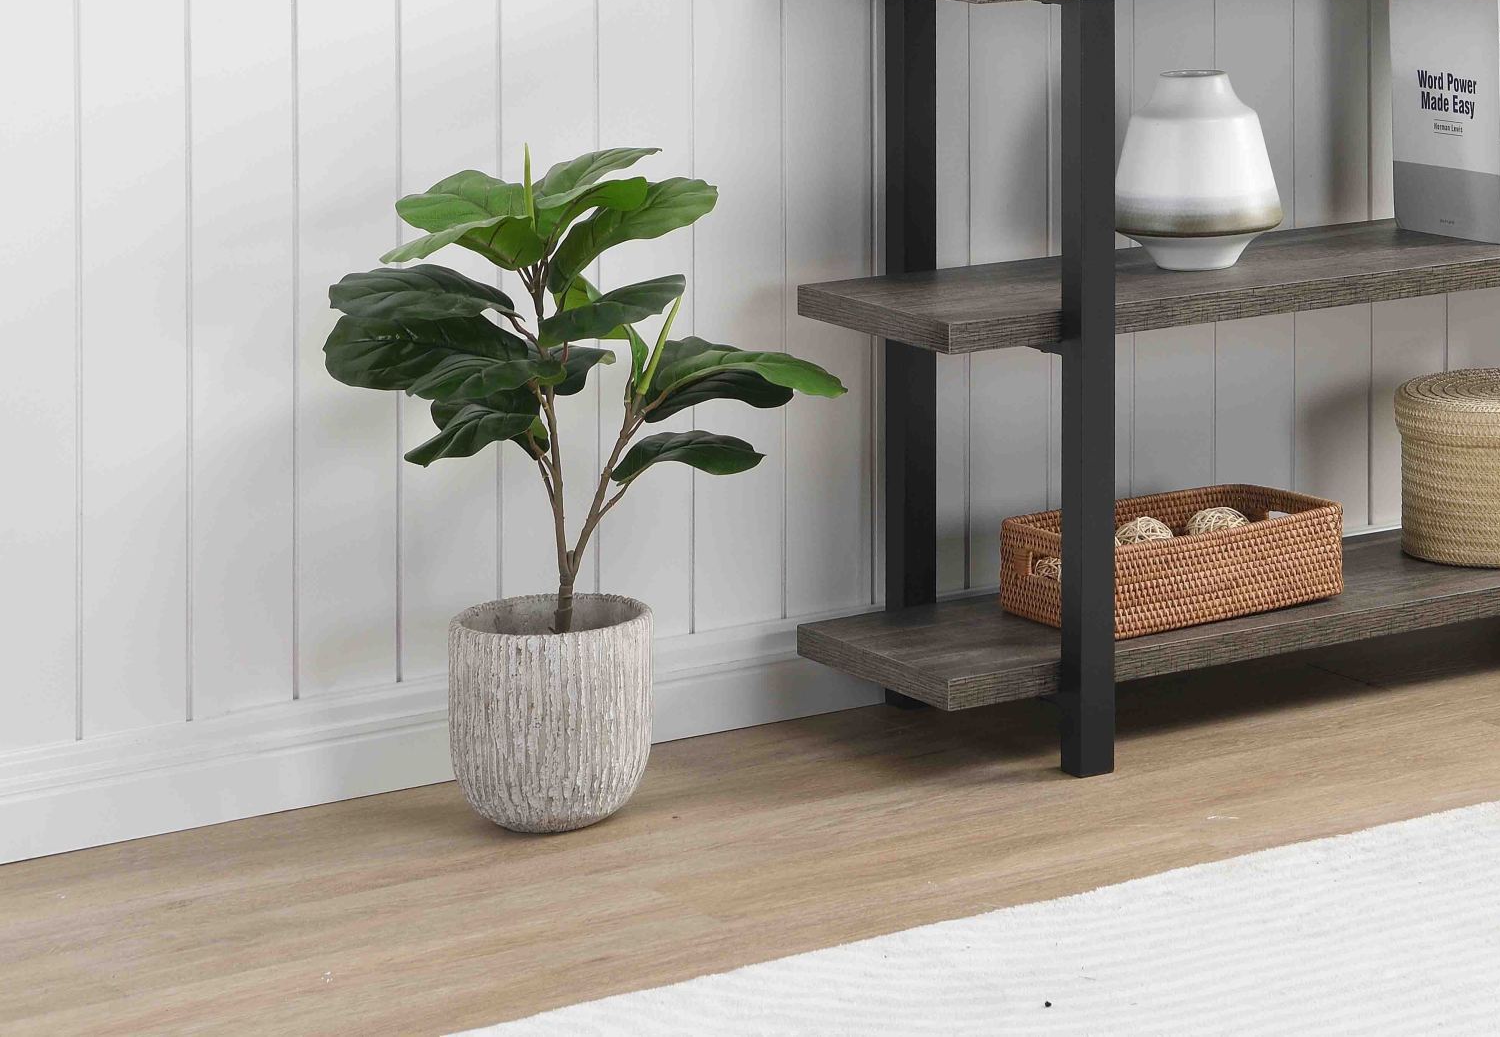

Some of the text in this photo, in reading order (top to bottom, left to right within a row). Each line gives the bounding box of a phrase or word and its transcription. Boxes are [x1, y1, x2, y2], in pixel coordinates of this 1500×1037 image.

[1417, 69, 1477, 95] Word Power
[1421, 91, 1476, 119] Made Easy
[1433, 122, 1451, 132] Norman
